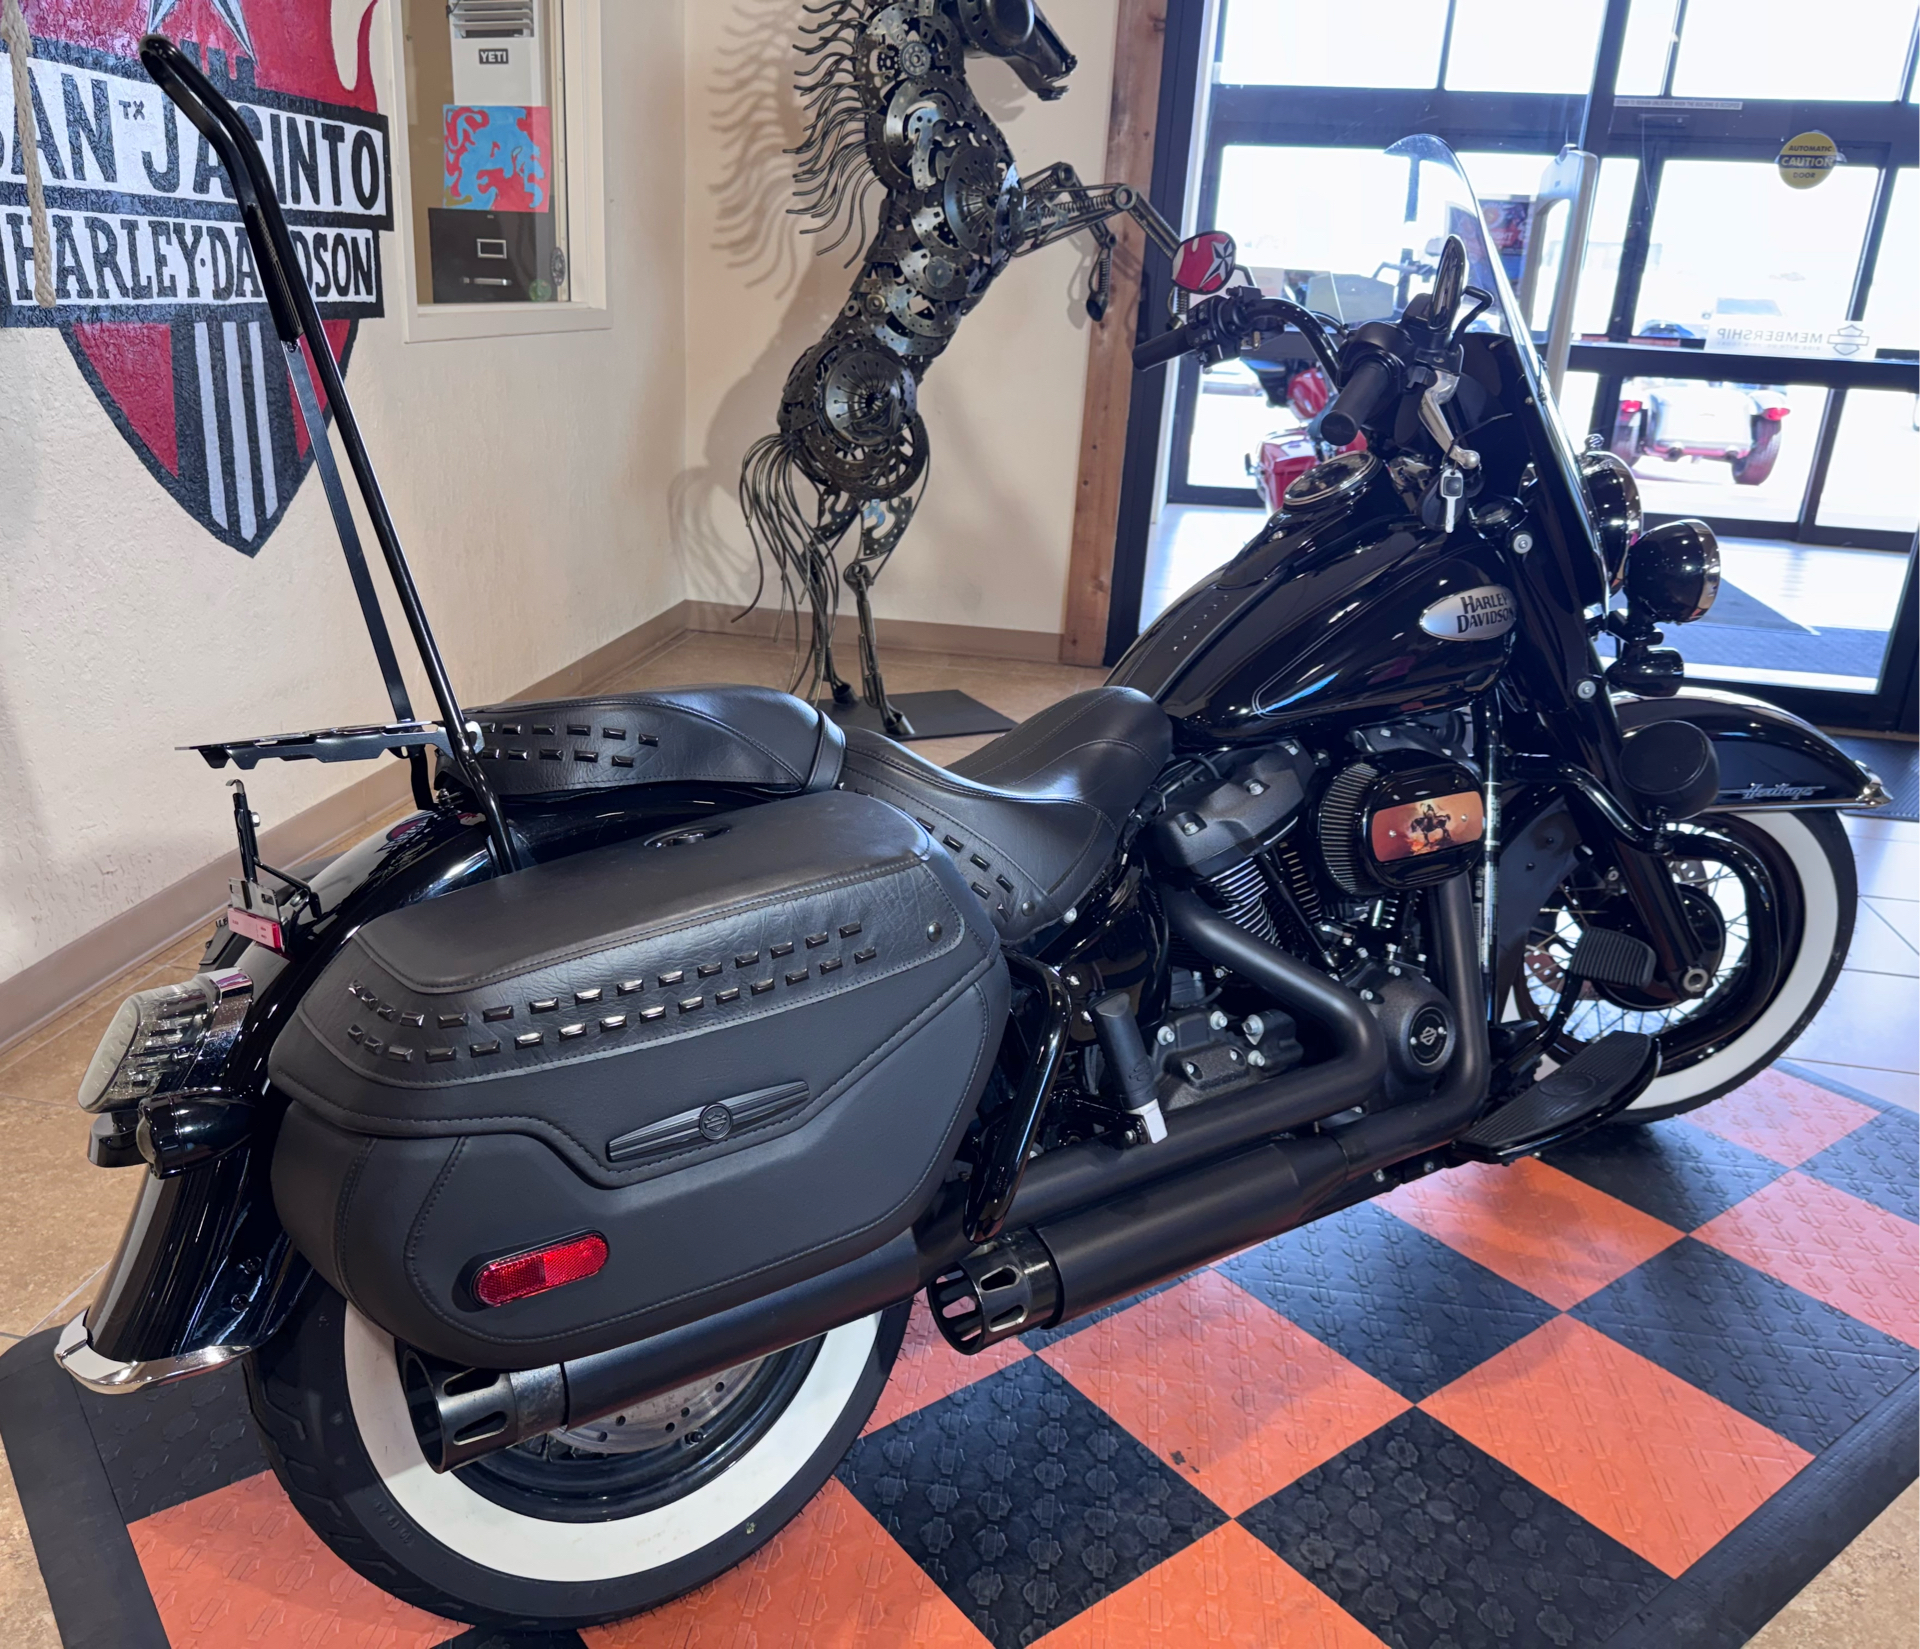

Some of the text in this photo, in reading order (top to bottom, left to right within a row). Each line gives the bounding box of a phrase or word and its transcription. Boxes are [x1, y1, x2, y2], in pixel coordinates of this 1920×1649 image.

[480, 51, 507, 62] YETI
[119, 100, 145, 120] TX
[1781, 157, 1835, 167] CAUTION
[1460, 593, 1508, 614] HARLEY
[1456, 608, 1513, 634] DAVIDSON
